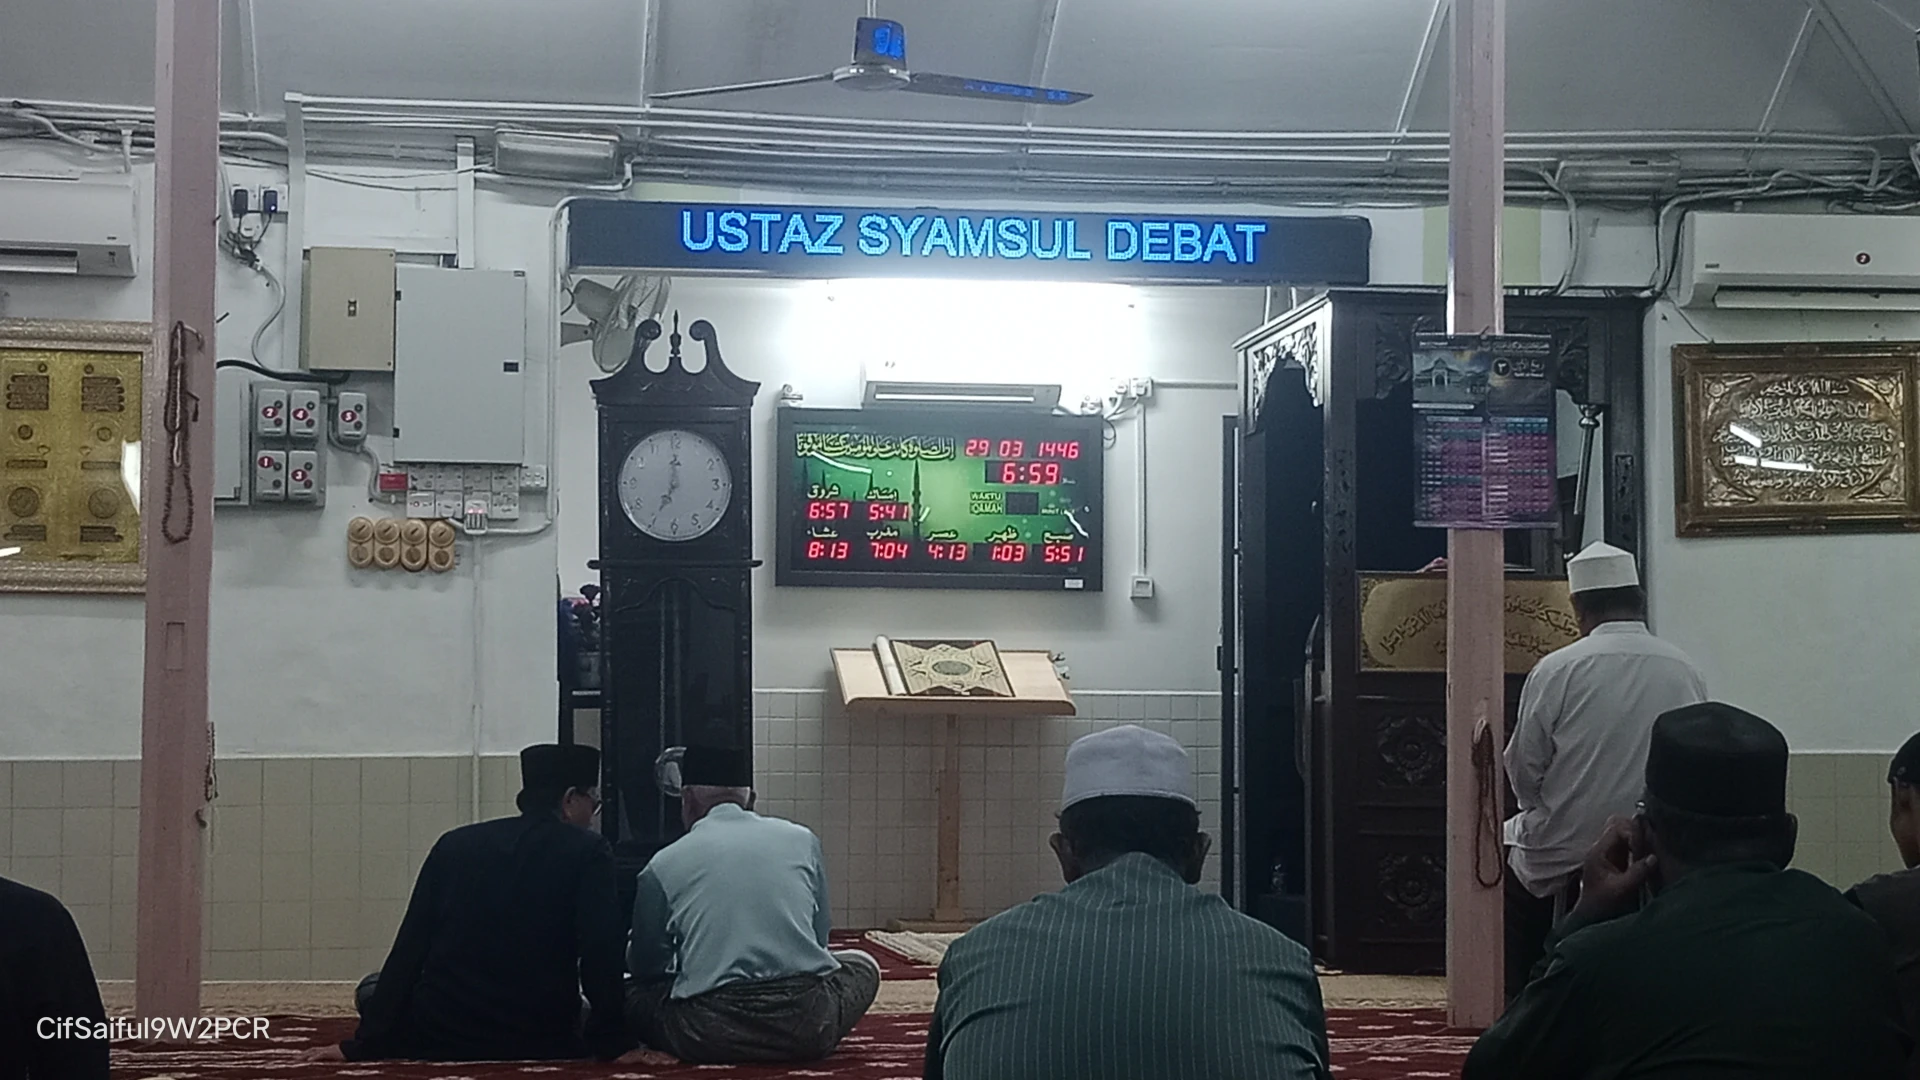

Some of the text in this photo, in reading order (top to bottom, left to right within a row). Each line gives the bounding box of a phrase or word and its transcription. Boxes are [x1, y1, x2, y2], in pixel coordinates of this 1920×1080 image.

[681, 210, 1268, 265] USTAZ SYAMSUL DEBAT
[266, 407, 275, 417] 2
[295, 409, 304, 419] 4
[344, 411, 352, 421] 5
[965, 439, 1079, 459] 29 03 1446
[706, 458, 715, 470] 2
[295, 470, 303, 480] 3
[1002, 462, 1059, 484] 6:59
[711, 478, 720, 491] 3
[807, 485, 839, 499] شروق
[971, 492, 1001, 501] WAKTU
[809, 502, 850, 519] 6:57
[869, 503, 909, 520] 5:41
[691, 513, 700, 526] 5
[808, 541, 849, 559] 8:13
[870, 542, 909, 559] 7:04
[927, 544, 967, 561] 4:13
[991, 544, 1025, 562] 1:03
[1044, 545, 1084, 563] 5:51
